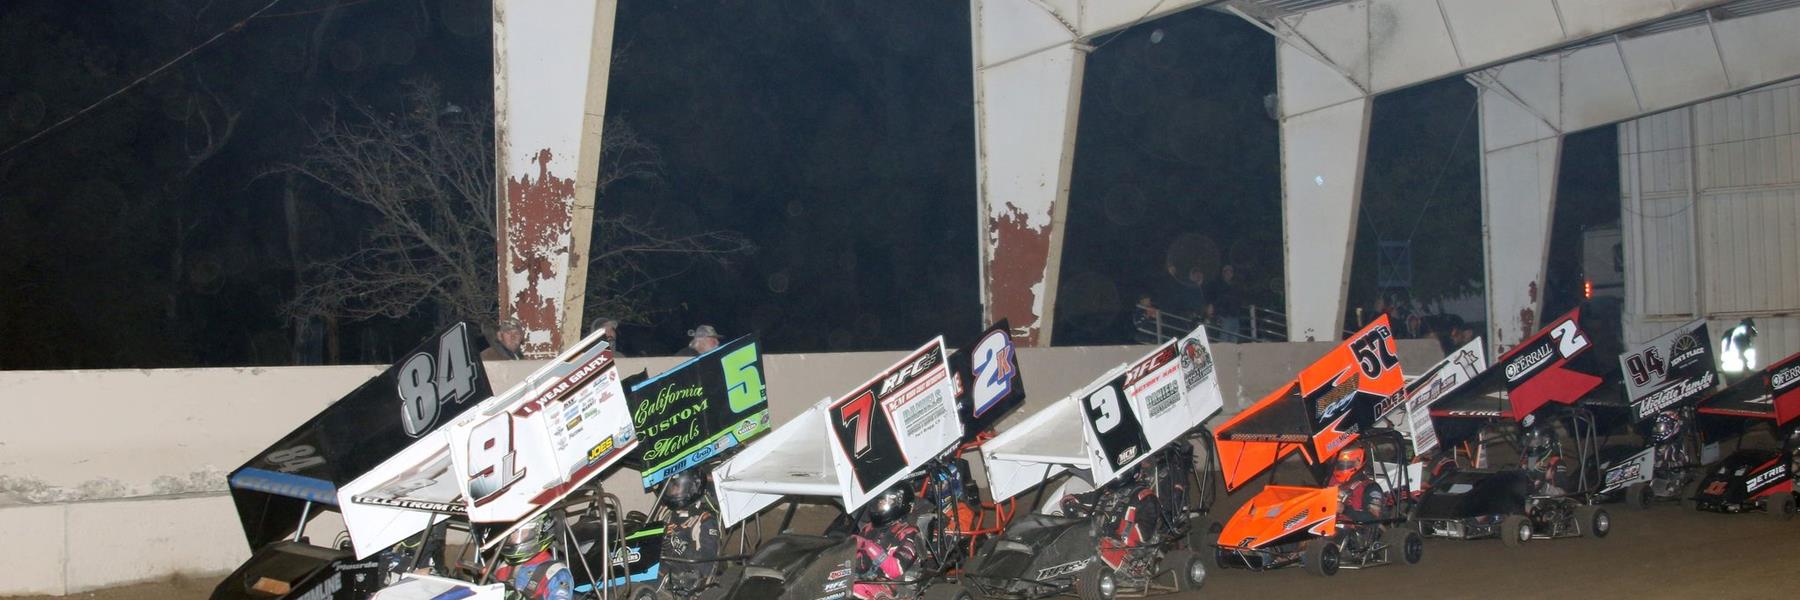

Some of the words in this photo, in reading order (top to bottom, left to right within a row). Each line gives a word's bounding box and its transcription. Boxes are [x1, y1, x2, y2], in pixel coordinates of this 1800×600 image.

[1551, 320, 1588, 358] 2
[398, 321, 478, 438] 84
[721, 342, 761, 413] 5
[1626, 346, 1665, 387] 94
[634, 383, 703, 428] California
[635, 399, 709, 443] CUSTOM
[841, 390, 877, 459] 7
[1090, 385, 1121, 433] 3
[588, 437, 613, 460] JOES
[643, 418, 700, 461] Metals
